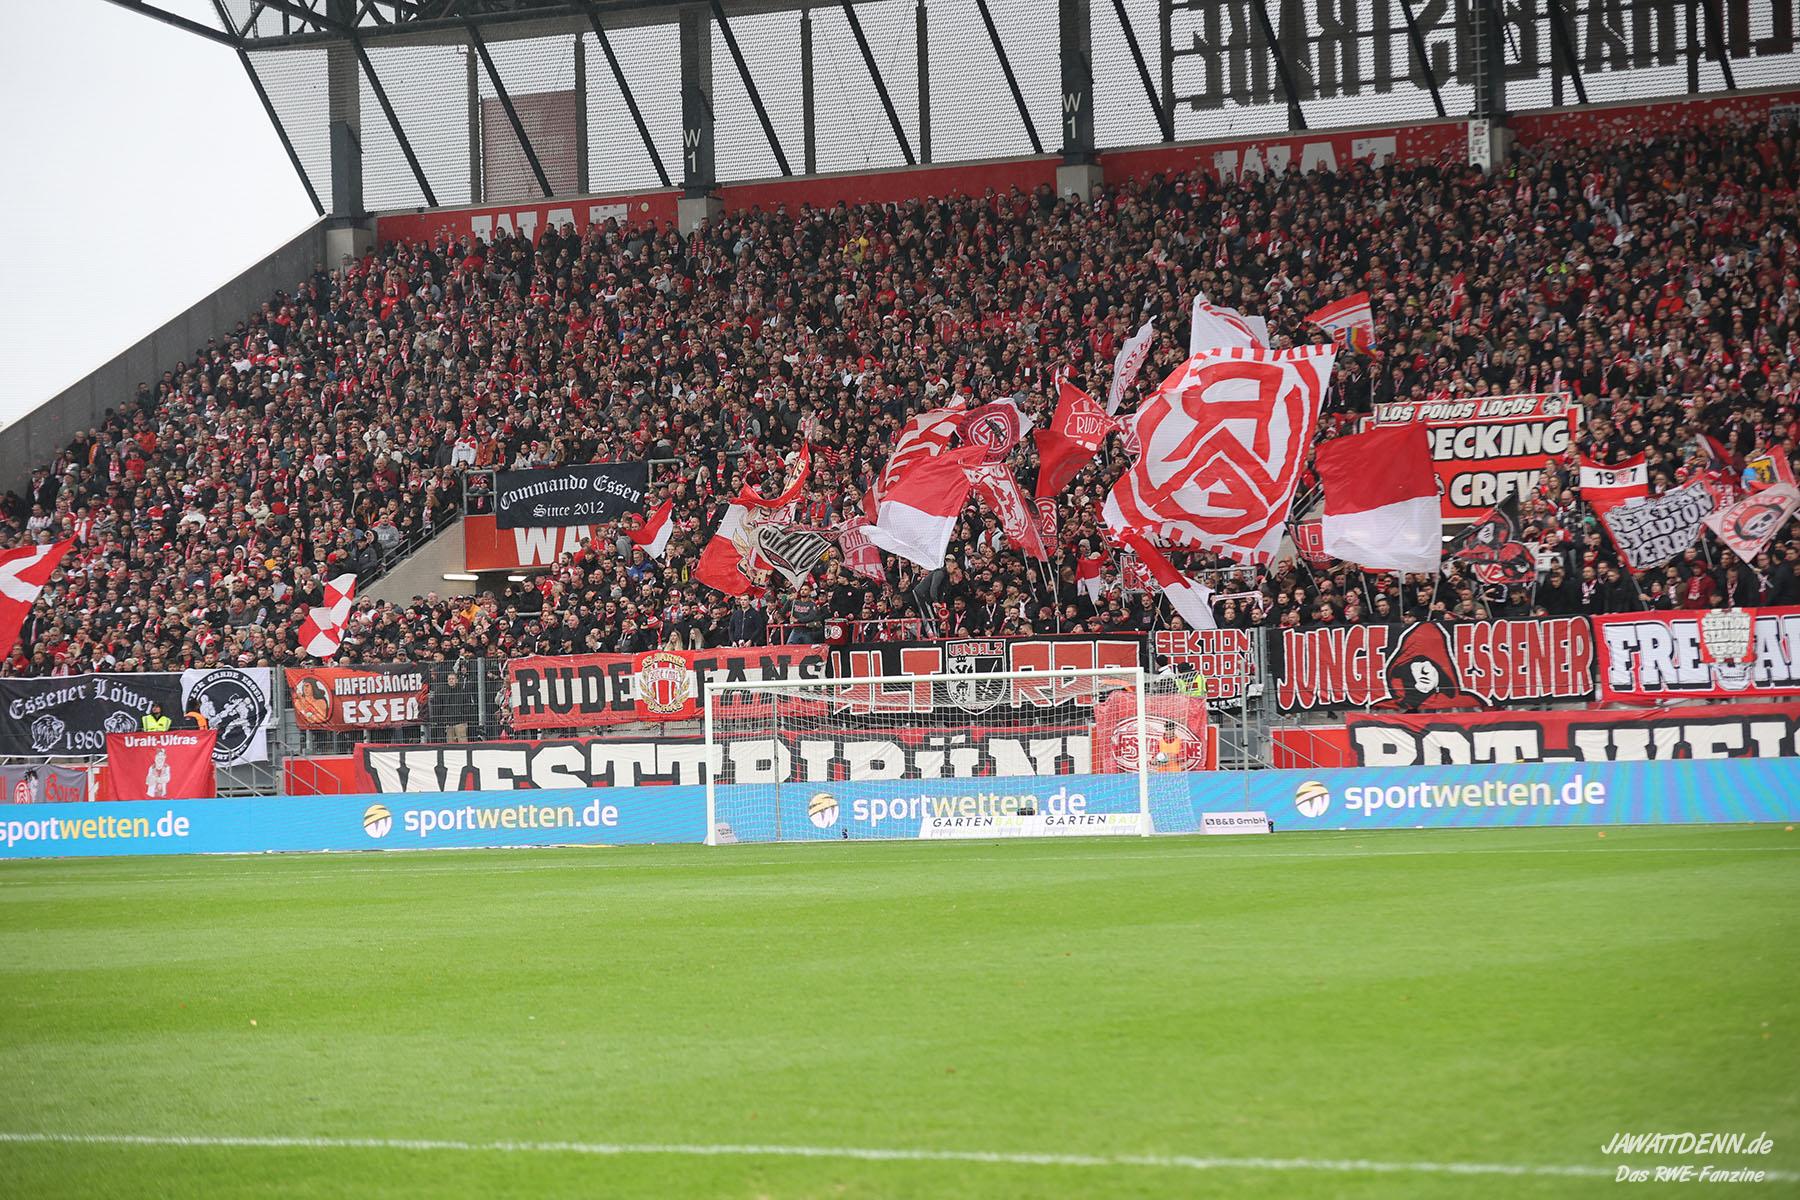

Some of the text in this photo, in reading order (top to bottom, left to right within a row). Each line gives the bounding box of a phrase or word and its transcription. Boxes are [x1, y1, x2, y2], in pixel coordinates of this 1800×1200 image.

[1062, 92, 1081, 112] W
[684, 129, 701, 148] W
[1067, 116, 1076, 139] 1
[688, 151, 696, 173] 1
[1379, 404, 1414, 422] LOS
[1478, 397, 1537, 418] LOCOS
[500, 474, 641, 511] Commando Essen
[533, 501, 605, 518] Since 2012
[949, 642, 1003, 656] VANDALZ
[1155, 629, 1251, 655] SEKTION
[1277, 615, 1594, 711] JUNGE ESSENER
[207, 669, 239, 682] GARDE
[240, 675, 264, 703] ESSEN
[334, 671, 423, 696] HAFENSÄNGER
[515, 661, 635, 717] RUDE
[9, 685, 86, 720] Essener
[342, 697, 420, 724] ESSEN
[65, 732, 104, 750] 1980
[124, 734, 198, 748] Uralt-Ultras
[853, 786, 1087, 827] sportwetten.de
[1344, 774, 1606, 817] sportwetten.de
[404, 799, 619, 838] sportwetten.de
[1237, 817, 1266, 825] GmbH
